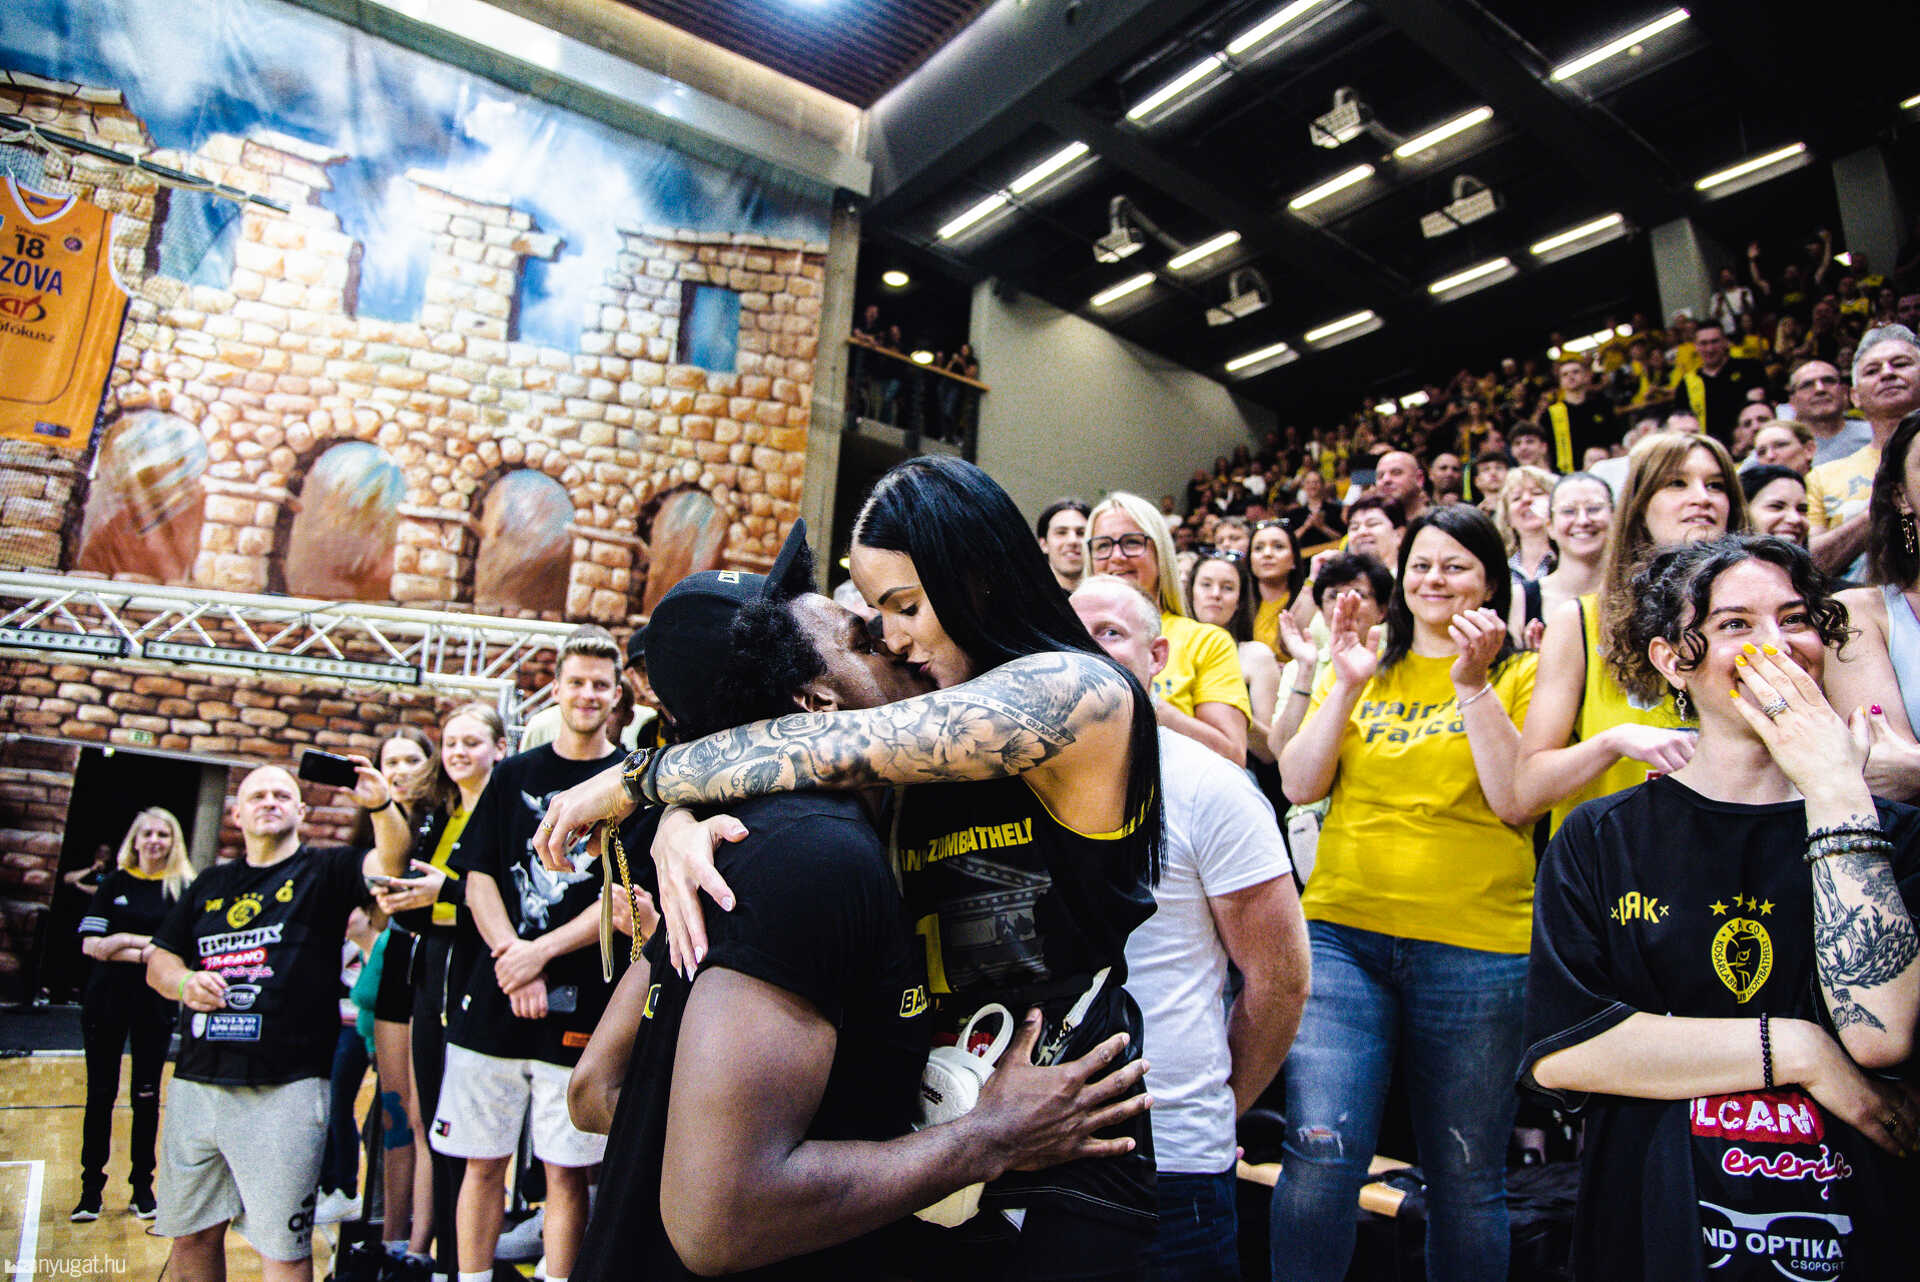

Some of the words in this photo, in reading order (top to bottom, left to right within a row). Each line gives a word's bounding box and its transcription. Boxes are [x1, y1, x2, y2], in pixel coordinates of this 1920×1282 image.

[15, 233, 45, 260] 18
[0, 256, 63, 296] ZOVA
[928, 817, 1033, 863] ZOMBATHELY
[1690, 1097, 1814, 1135] LCAN
[1745, 1232, 1844, 1260] OPTIKA
